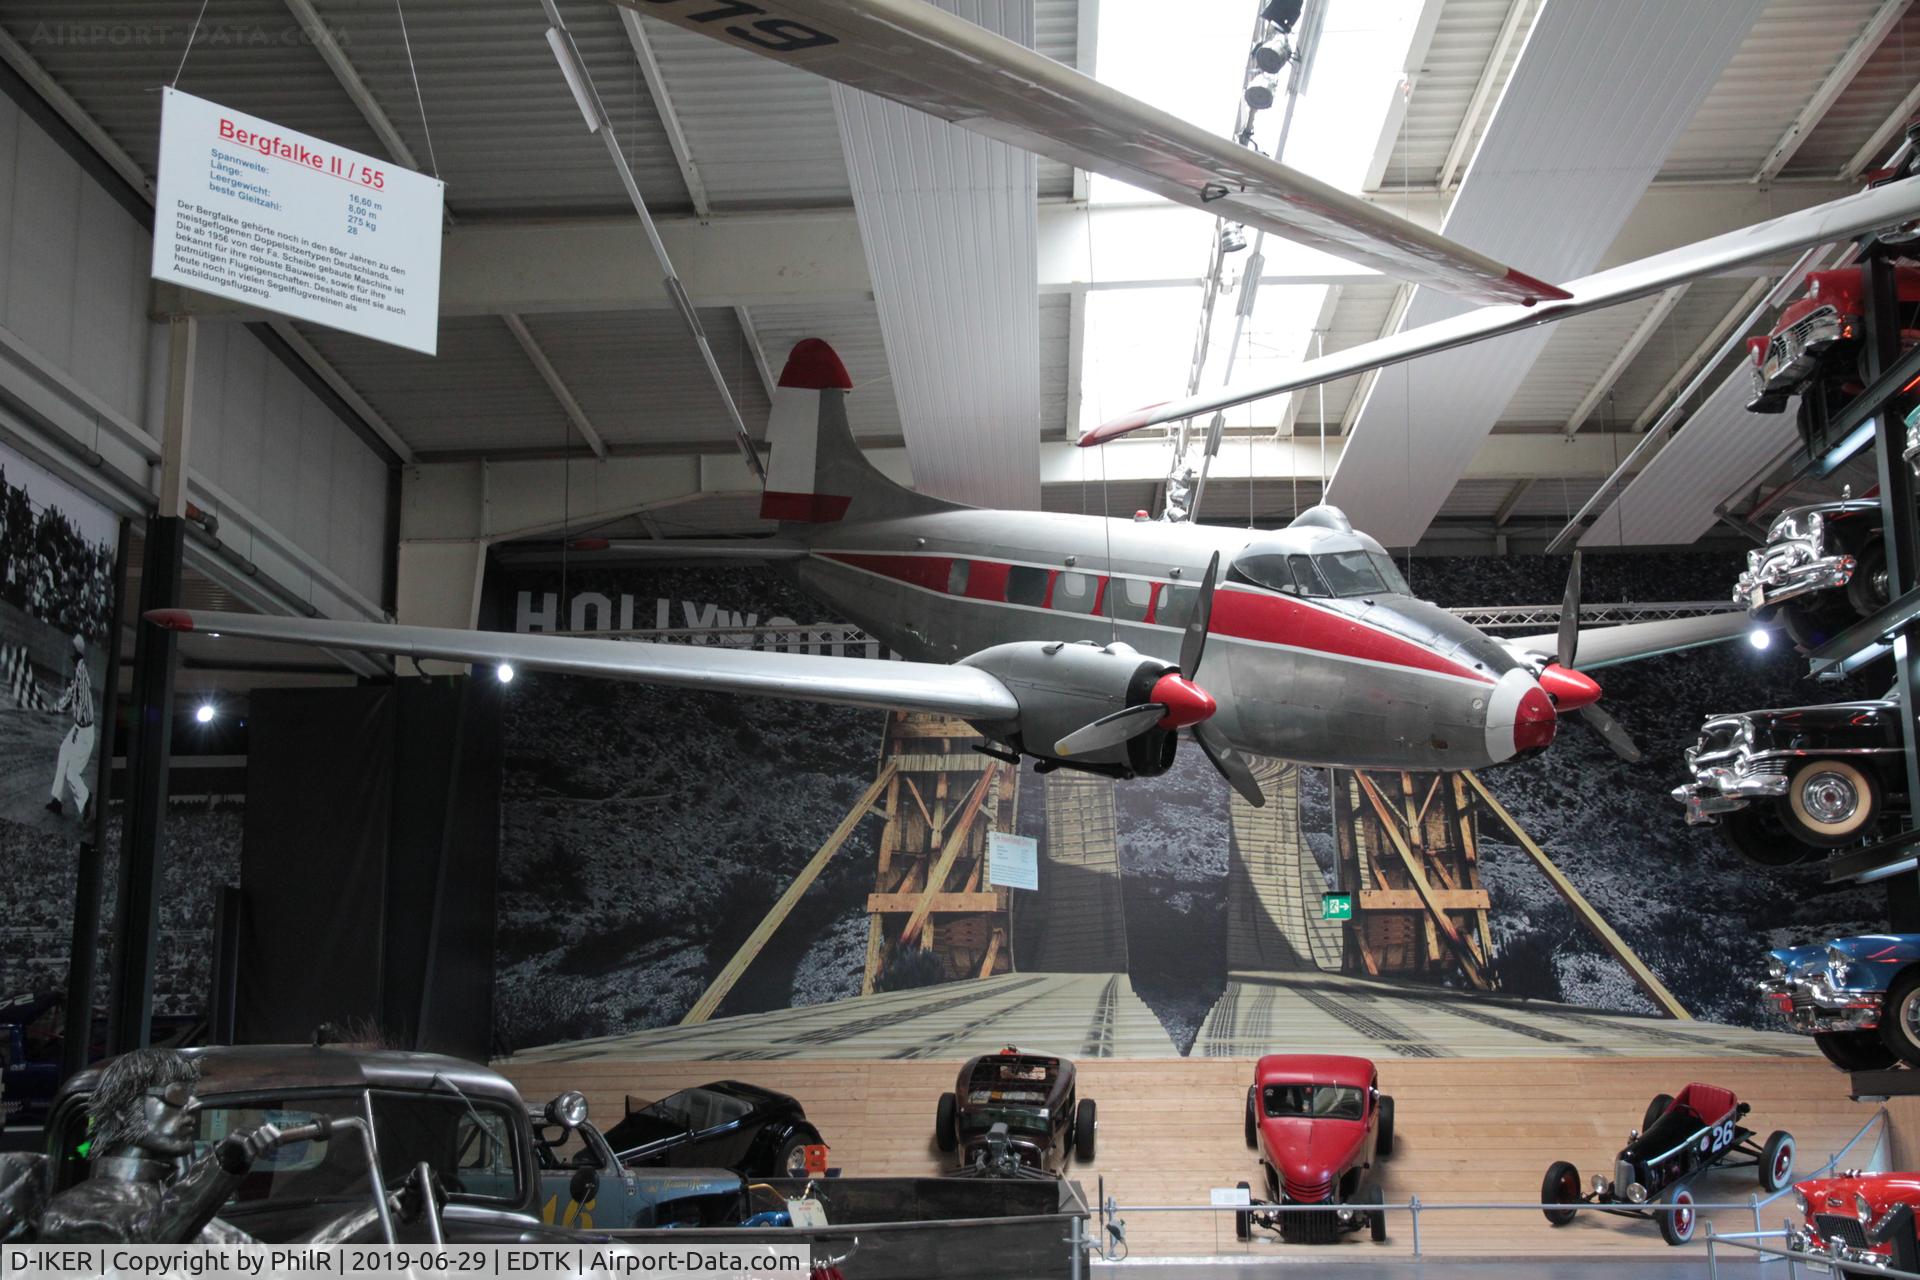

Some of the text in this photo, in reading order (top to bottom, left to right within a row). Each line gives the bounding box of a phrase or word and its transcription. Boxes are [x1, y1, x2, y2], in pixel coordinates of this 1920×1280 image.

[211, 148, 382, 211] Spannweite: 16,60 m
[219, 118, 323, 169] Bergfalke
[348, 162, 355, 178] /
[361, 167, 385, 189] 55
[209, 182, 236, 196] beste
[238, 191, 283, 212] Gleitzahl:
[210, 159, 377, 220] Länge: 8,00 m
[210, 170, 377, 232] Leergewicht: 275 kg
[176, 211, 392, 282] meistgeflogenen Doppelsitzertypen Deutschlands.
[176, 220, 404, 296] Die ab 1956 von der Fa. Scheibe gebaute Maschine ist
[176, 231, 386, 300] bekannt für ihre robuste Bauweise, sowie für ihre
[177, 200, 406, 276] Der Bergfalke gehörte noch in den 80er Jahren zu den
[173, 264, 272, 298] Ausbildungsflugzeug.
[174, 243, 406, 316] gutmütigen Flugeigenschaften. Deshalb dient sie auch
[174, 252, 358, 312] heute noch in vielen Segelflugvereinen als
[1711, 1119, 1734, 1153] 26
